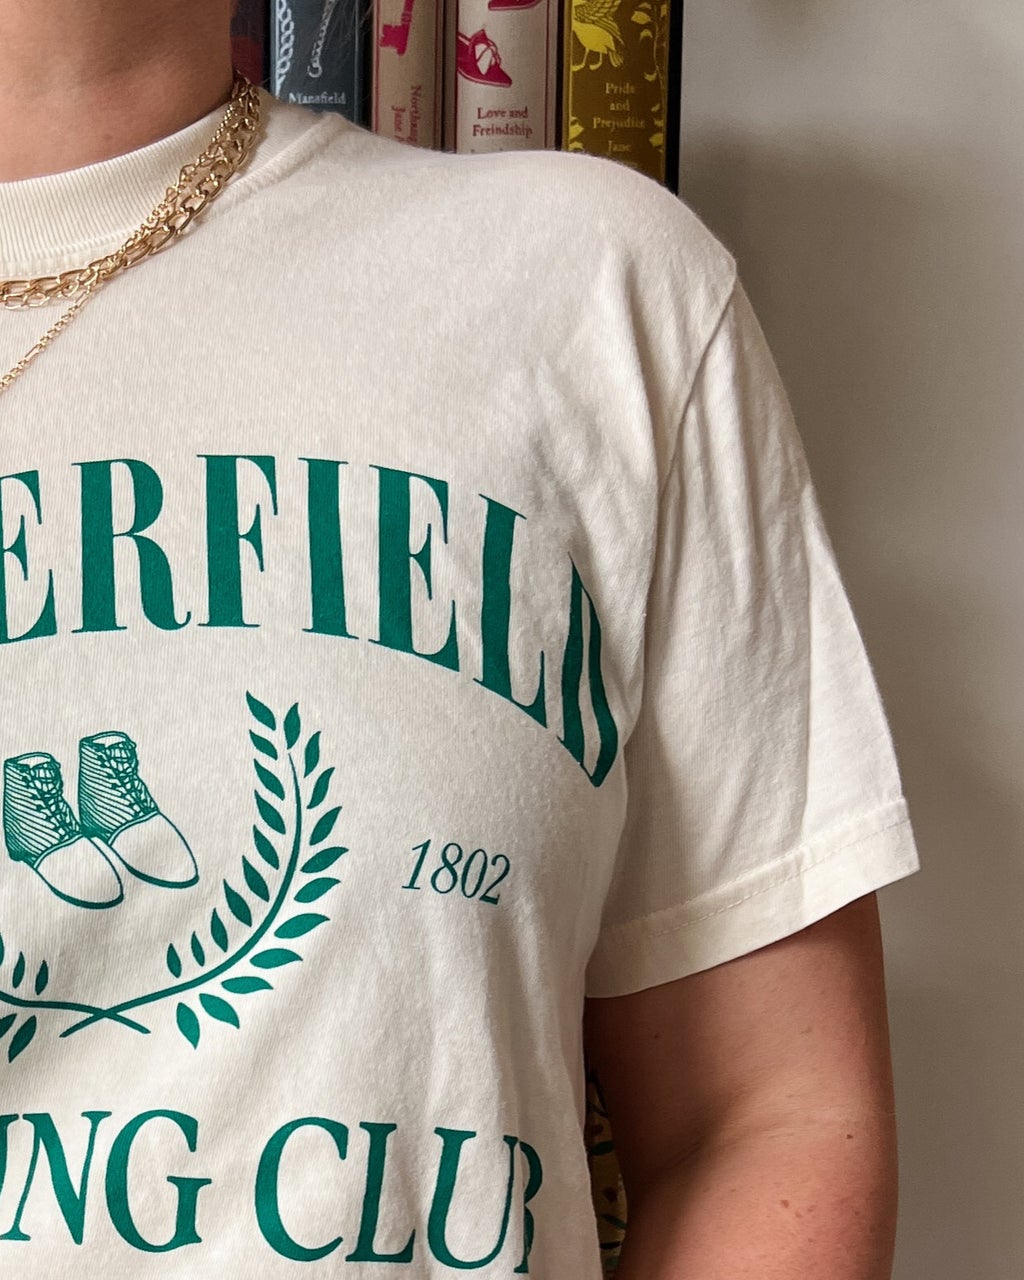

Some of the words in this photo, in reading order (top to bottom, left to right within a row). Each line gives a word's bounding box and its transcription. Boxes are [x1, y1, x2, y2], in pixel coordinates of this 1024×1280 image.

[605, 82, 636, 95] Pride
[288, 91, 346, 105] Mansfield
[609, 100, 631, 111] and
[408, 85, 422, 142] Northang
[477, 107, 507, 119] Love
[509, 107, 529, 119] and
[472, 124, 533, 139] Freindship
[592, 117, 646, 132] Prejudice
[607, 140, 633, 154] Jane
[402, 839, 511, 905] 1802
